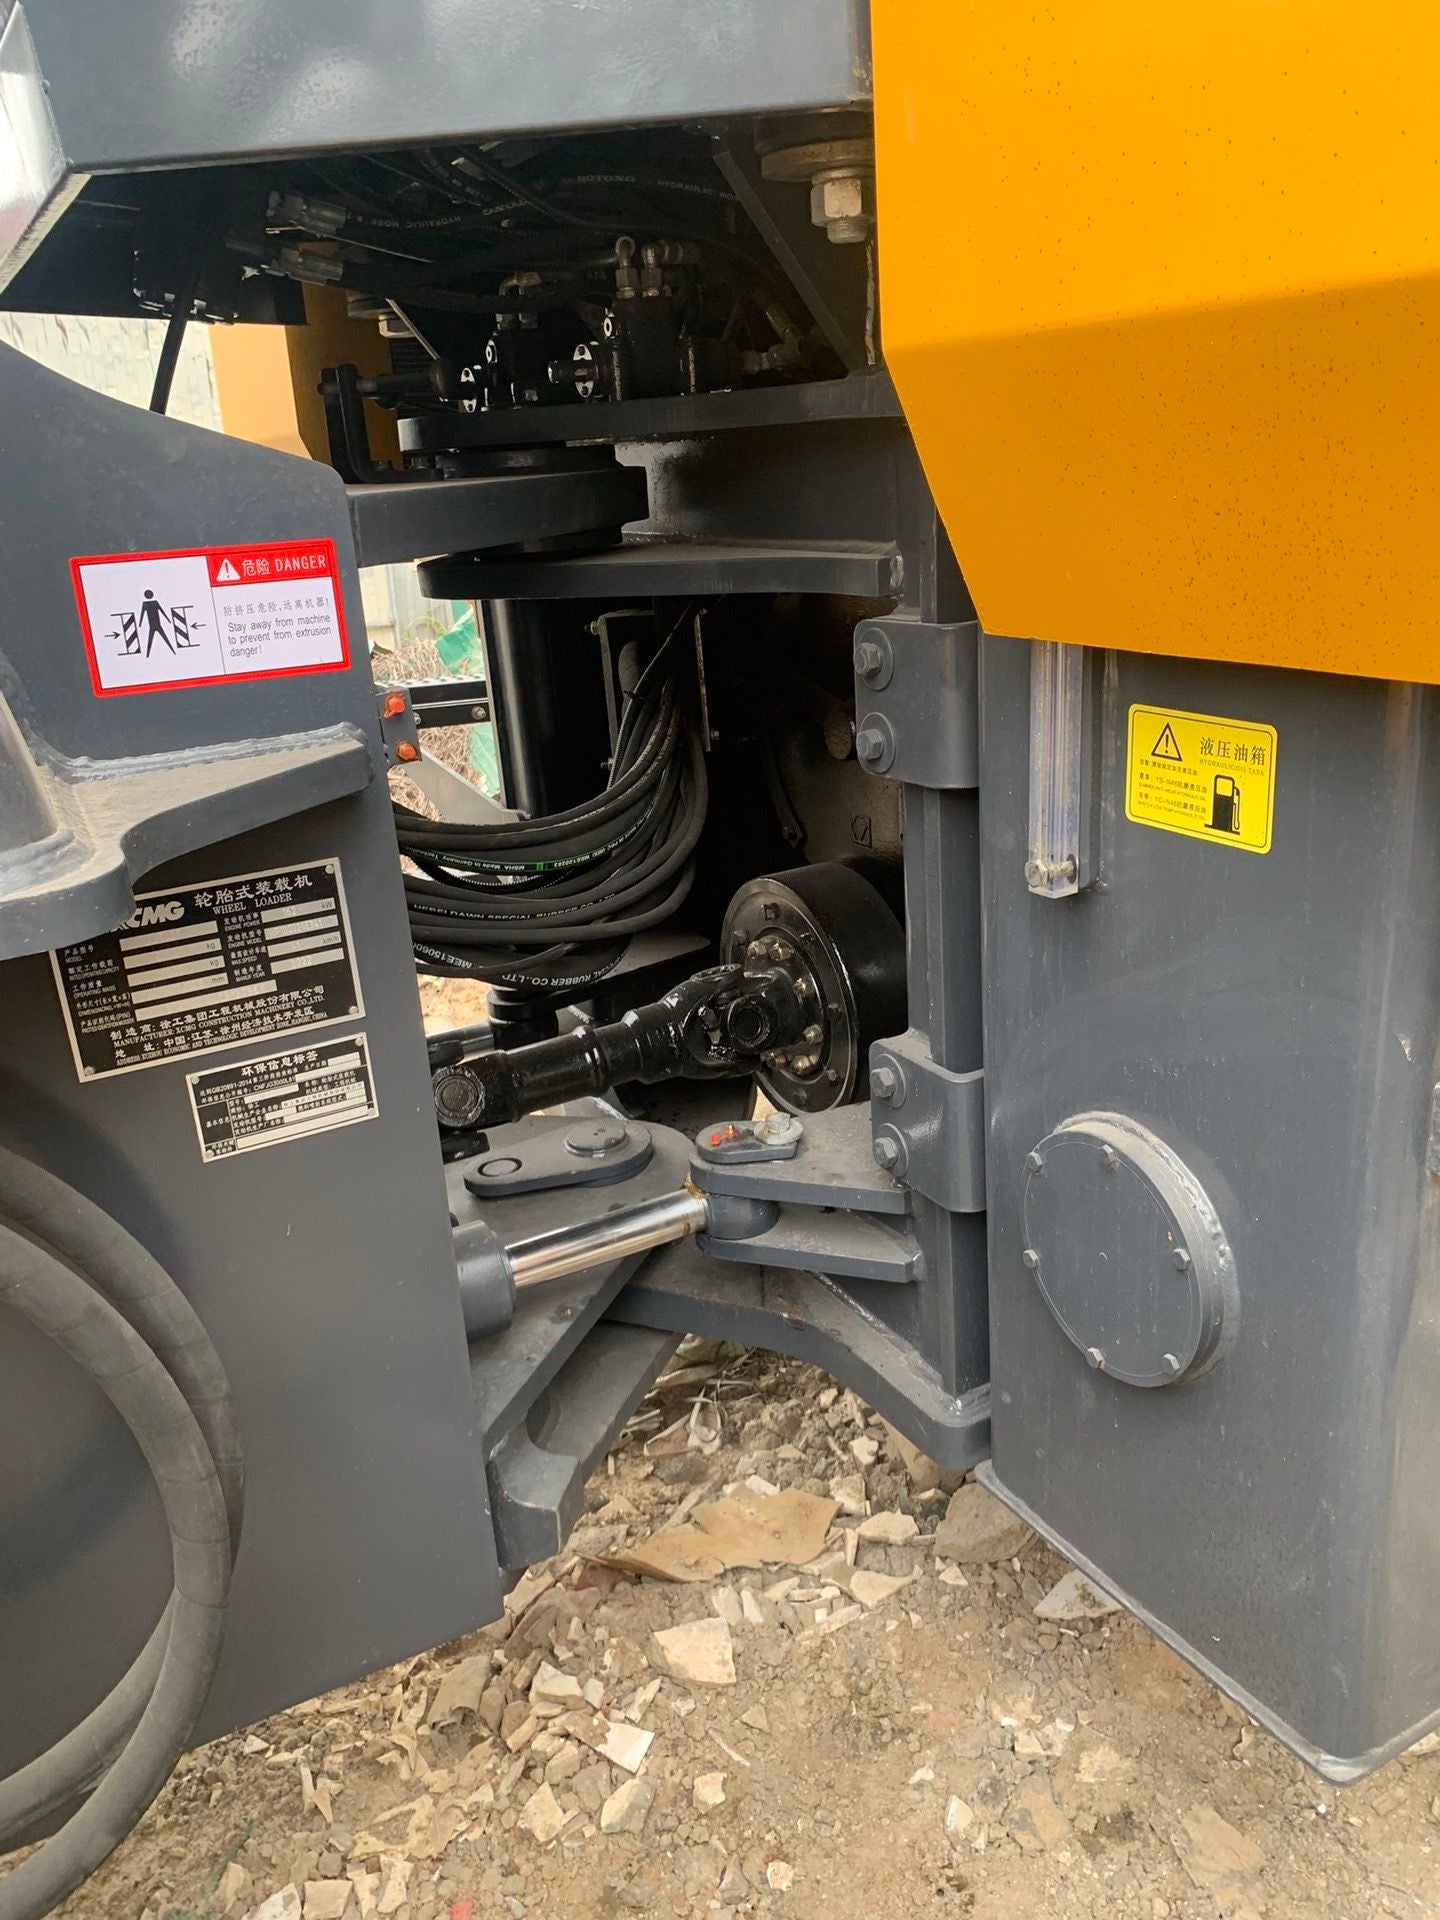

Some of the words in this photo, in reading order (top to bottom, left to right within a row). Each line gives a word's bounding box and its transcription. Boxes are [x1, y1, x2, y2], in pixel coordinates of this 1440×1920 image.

[242, 559, 270, 577] 危险
[274, 554, 327, 573] DANGER
[228, 621, 247, 634] Stay
[250, 620, 271, 632] away
[275, 617, 293, 628] from
[297, 614, 330, 626] machine
[228, 634, 237, 645] to
[240, 632, 270, 645] prevent
[273, 629, 292, 640] from
[296, 625, 331, 637] extrusion
[230, 644, 262, 658] danger!
[1200, 736, 1266, 767] 液压油箱
[442, 855, 473, 867] Germany
[482, 861, 501, 870] Made
[194, 874, 313, 909] 轮胎式装载机
[212, 900, 246, 915] WHEEL
[254, 891, 292, 907] LOADER
[550, 972, 592, 987] RUBBER
[174, 1023, 196, 1034] XCMG
[197, 1010, 252, 1029] CONSTRUCTION
[254, 1000, 295, 1016] MACHINERY
[191, 1039, 203, 1048] AND
[241, 1050, 318, 1077] 环保信息标签
